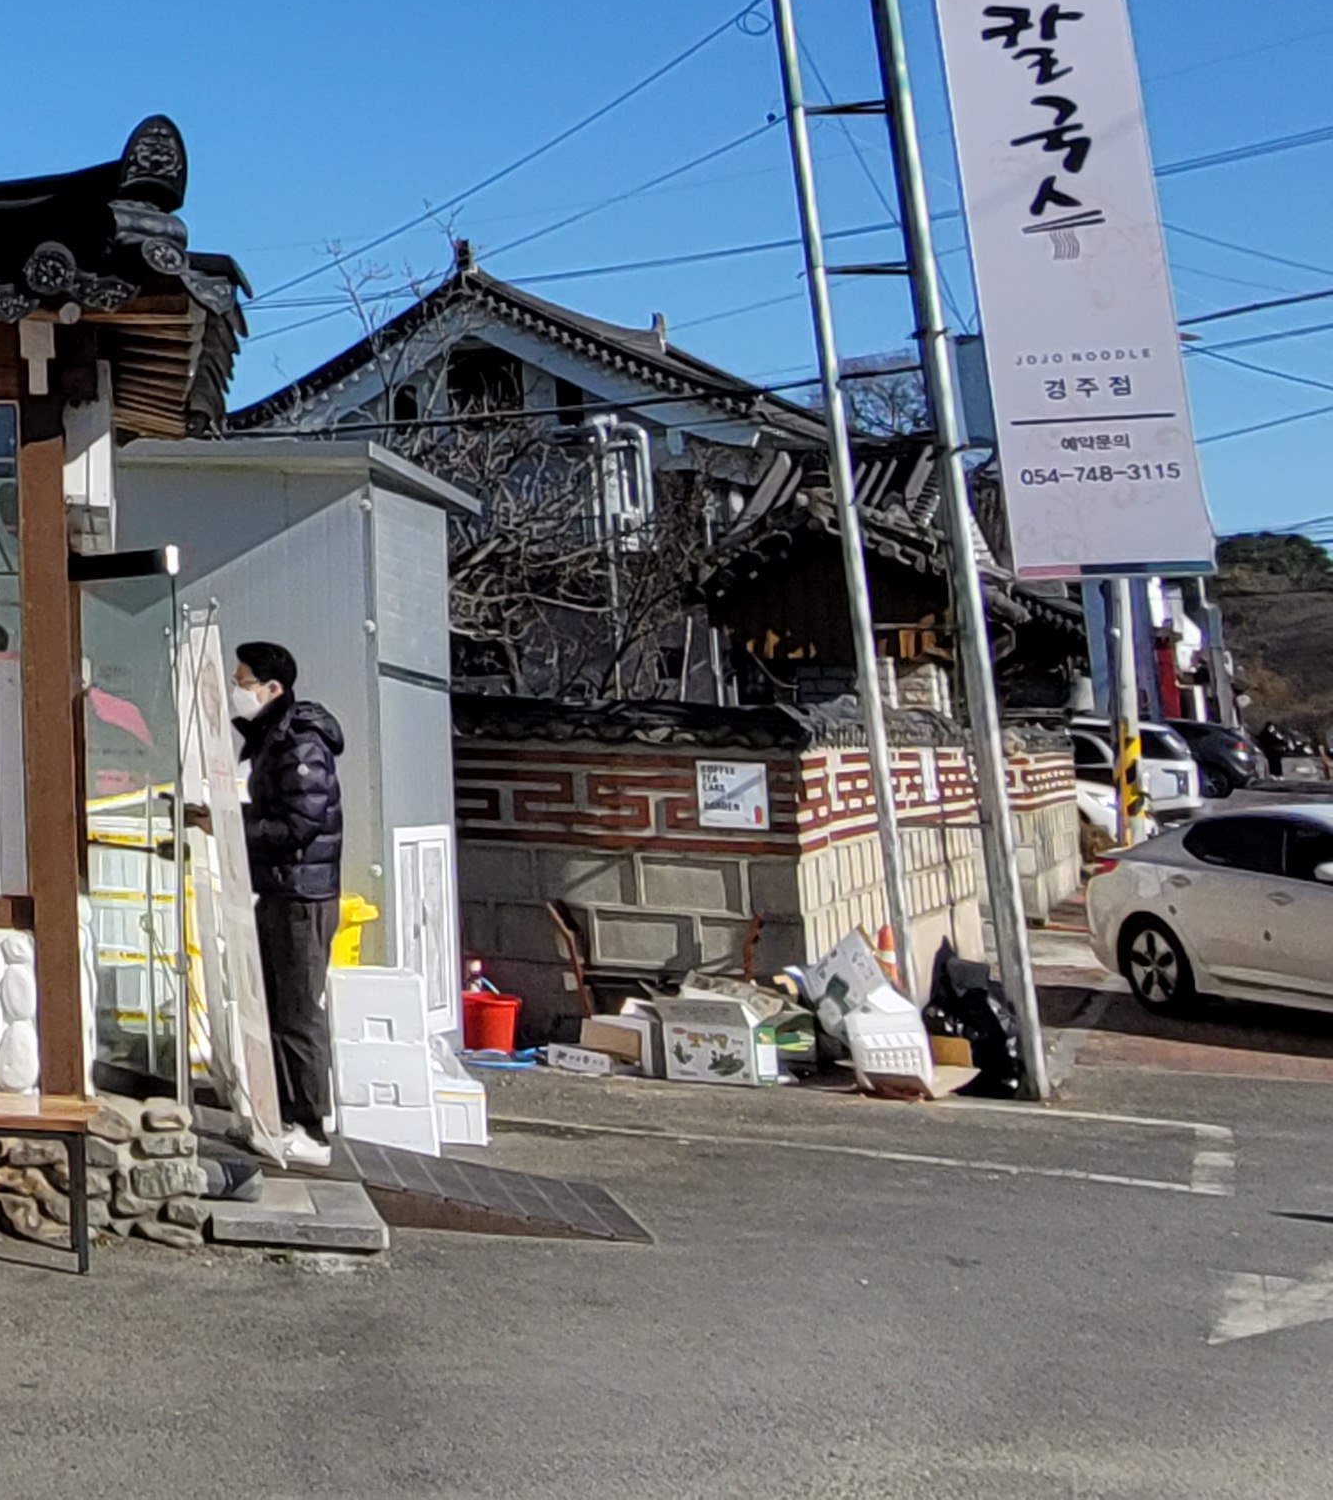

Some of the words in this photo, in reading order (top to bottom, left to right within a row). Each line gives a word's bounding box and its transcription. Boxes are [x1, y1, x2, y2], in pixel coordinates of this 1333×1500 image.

[1014, 352, 1064, 367] JOJO
[1070, 348, 1152, 363] NOODLE
[1043, 374, 1133, 401] 경주점
[1060, 433, 1132, 452] 예약문의
[1020, 462, 1181, 486] 054-748-3115
